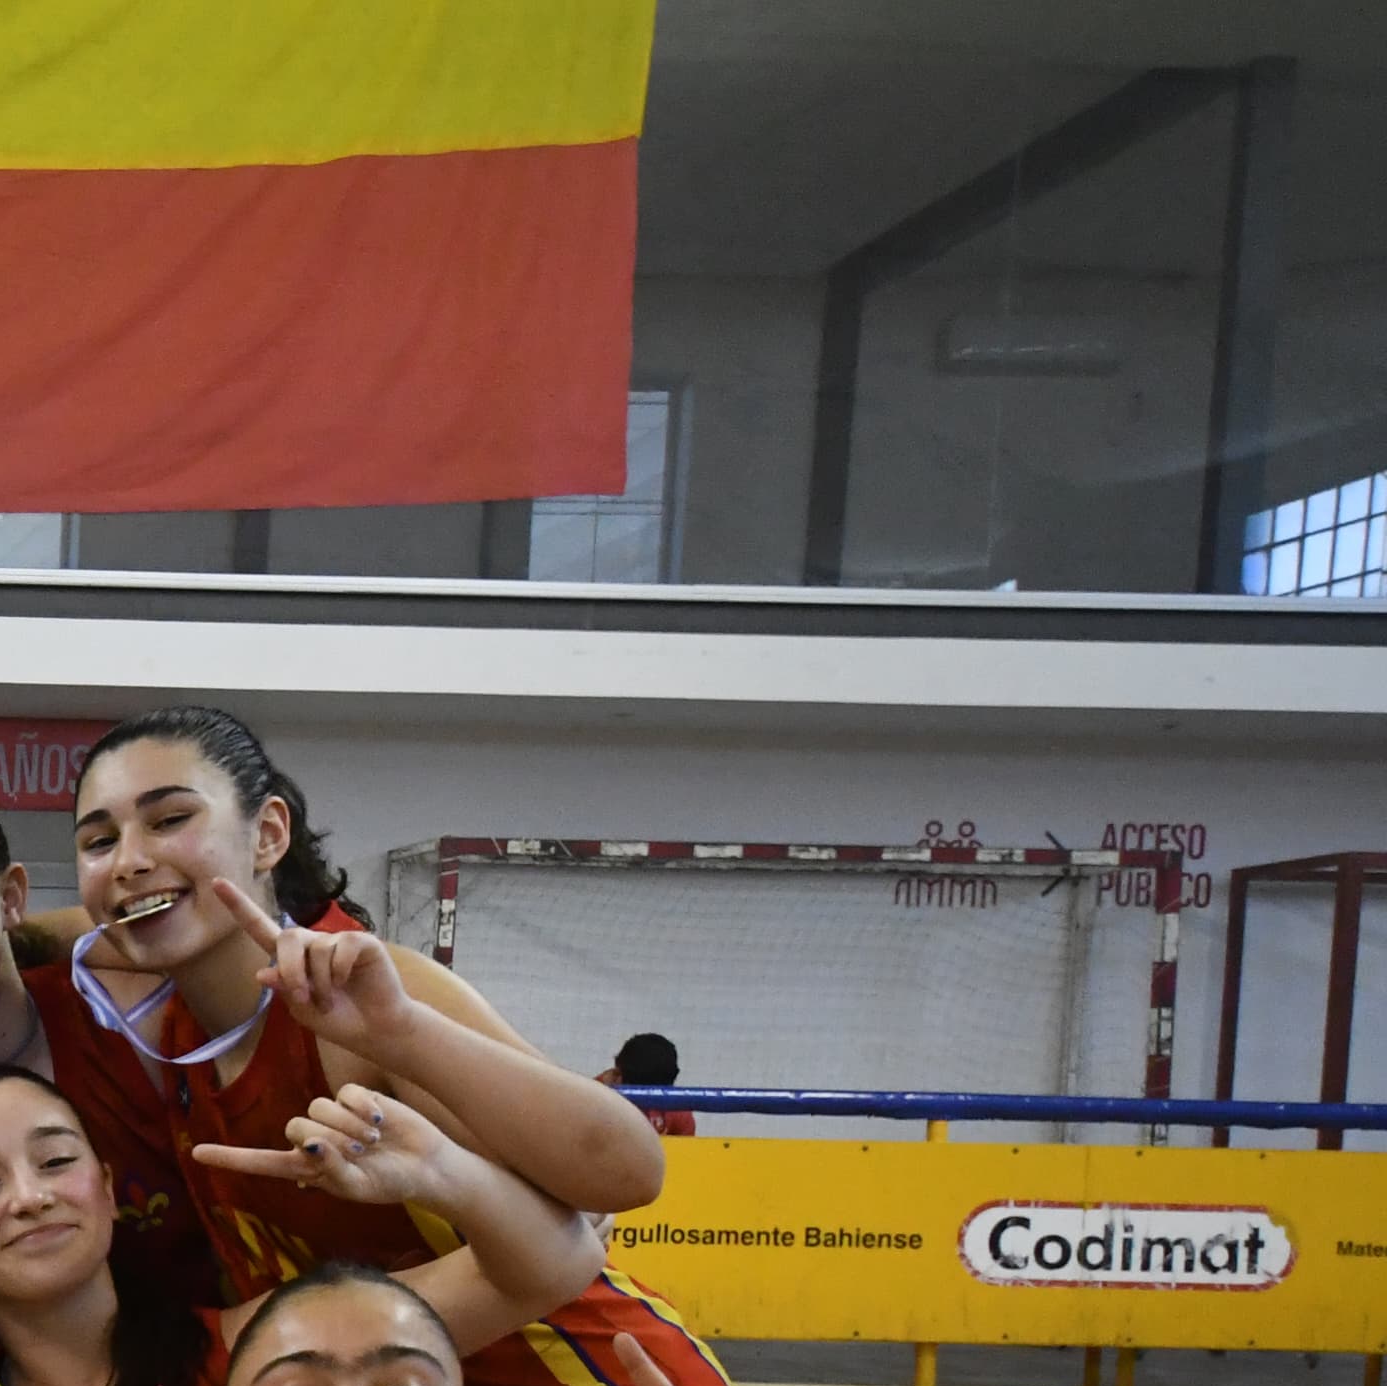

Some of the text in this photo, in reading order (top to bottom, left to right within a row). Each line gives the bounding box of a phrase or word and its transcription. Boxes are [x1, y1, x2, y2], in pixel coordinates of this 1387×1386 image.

[612, 1223, 923, 1249] rgullosamente Bahiense
[988, 1215, 1266, 1274] Codimat
